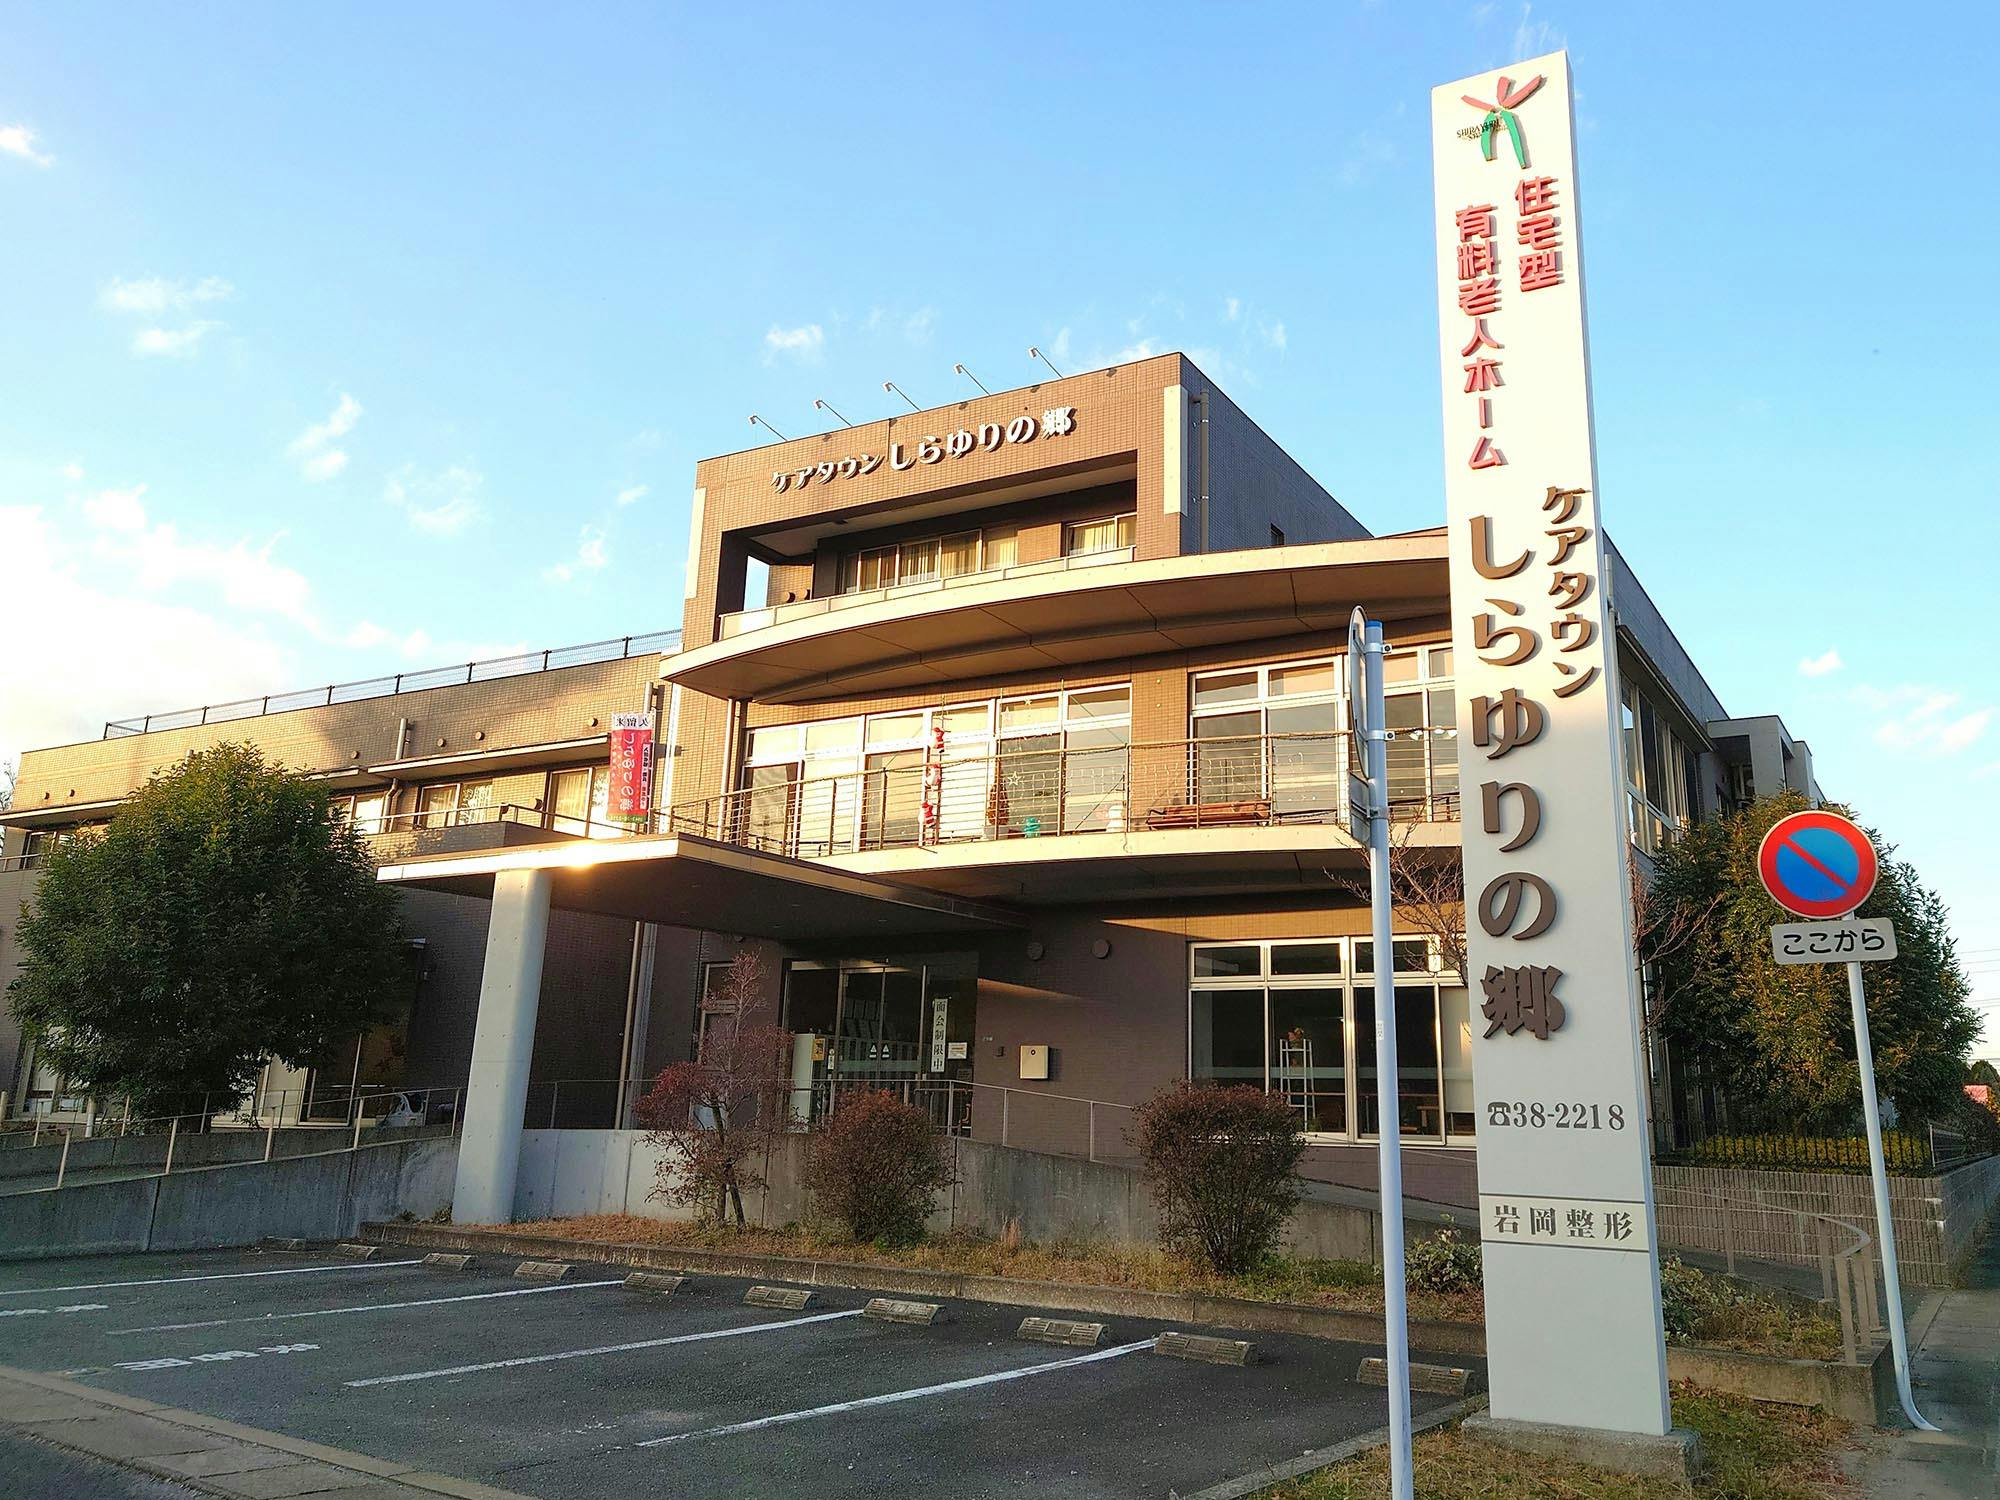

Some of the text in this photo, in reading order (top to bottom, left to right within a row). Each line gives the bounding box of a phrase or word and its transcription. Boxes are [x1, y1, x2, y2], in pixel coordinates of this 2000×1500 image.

[1515, 175, 1559, 292] 住宅型
[1455, 204, 1504, 470] 有料老人ホーム
[770, 405, 1076, 494] ケアタウン しらゆりの郷
[1542, 486, 1596, 698] ケアタウン
[1469, 514, 1567, 1041] しらゆりの郷
[1783, 928, 1886, 956] ここから
[934, 1001, 946, 1070] 面会制限中
[1494, 1204, 1633, 1242] 岩岡整形
